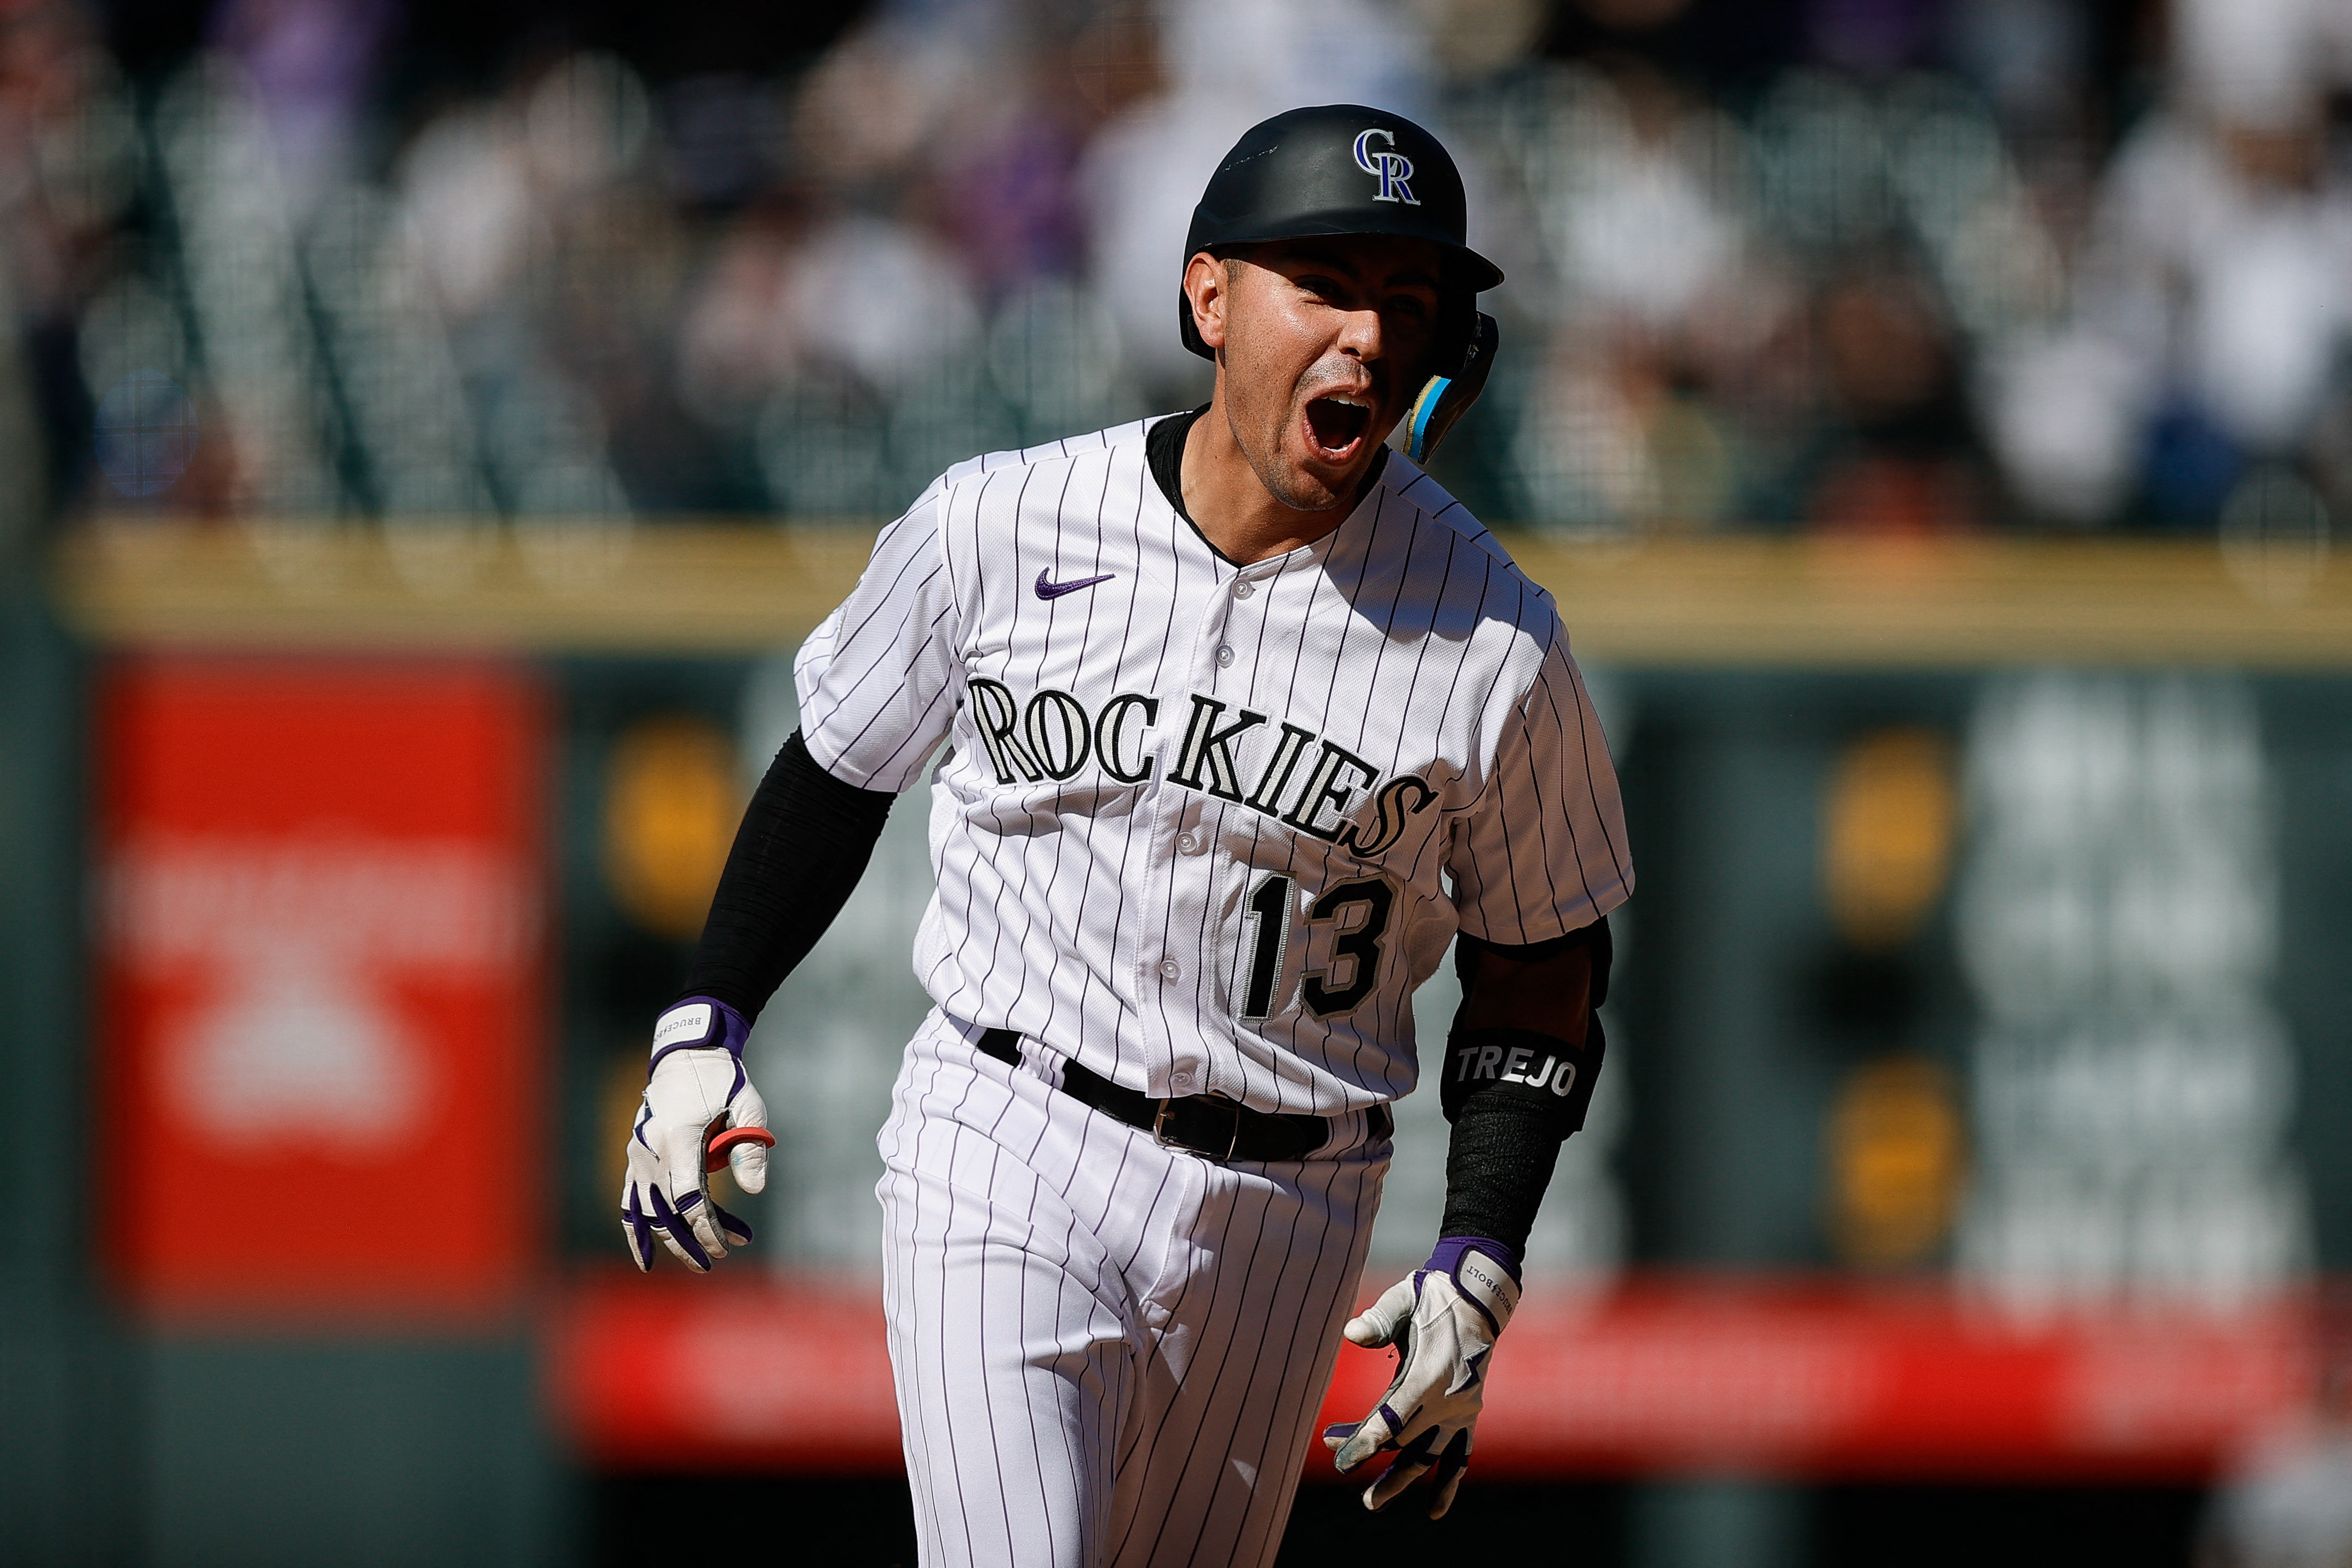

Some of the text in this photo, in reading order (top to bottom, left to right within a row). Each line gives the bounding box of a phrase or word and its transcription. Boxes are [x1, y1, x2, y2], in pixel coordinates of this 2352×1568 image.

[1353, 129, 1421, 206] CR
[967, 677, 1439, 858] ROCKIES
[1239, 871, 1404, 1023] 13
[1458, 1045, 1576, 1096] TREJO
